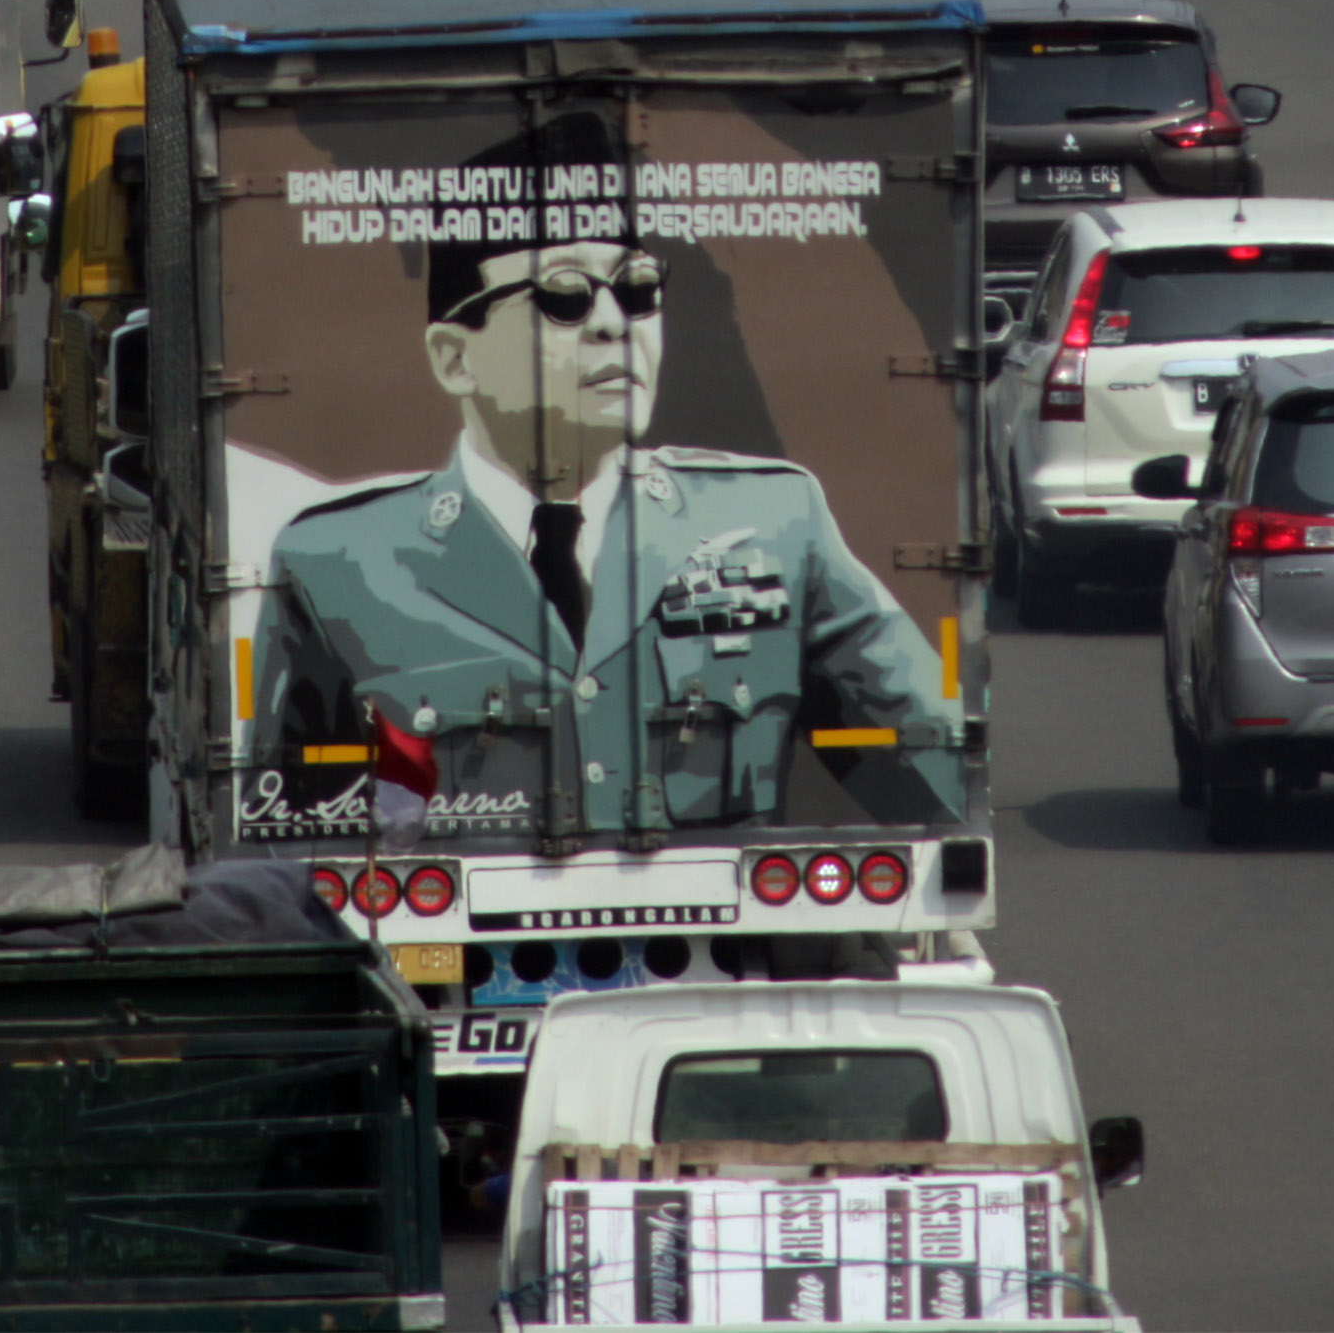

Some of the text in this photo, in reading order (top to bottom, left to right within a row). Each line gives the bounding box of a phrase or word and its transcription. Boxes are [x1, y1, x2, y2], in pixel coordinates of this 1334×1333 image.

[288, 167, 434, 206] BANGUNLAH
[437, 166, 522, 203] SUATU
[696, 162, 777, 198] SEMUA
[781, 158, 881, 197] BANGSA
[302, 206, 385, 244] HIDUP
[390, 206, 482, 242] DALAM
[1197, 382, 1208, 403] B
[779, 1194, 824, 1264] GRESS
[919, 1190, 963, 1259] GRESS
